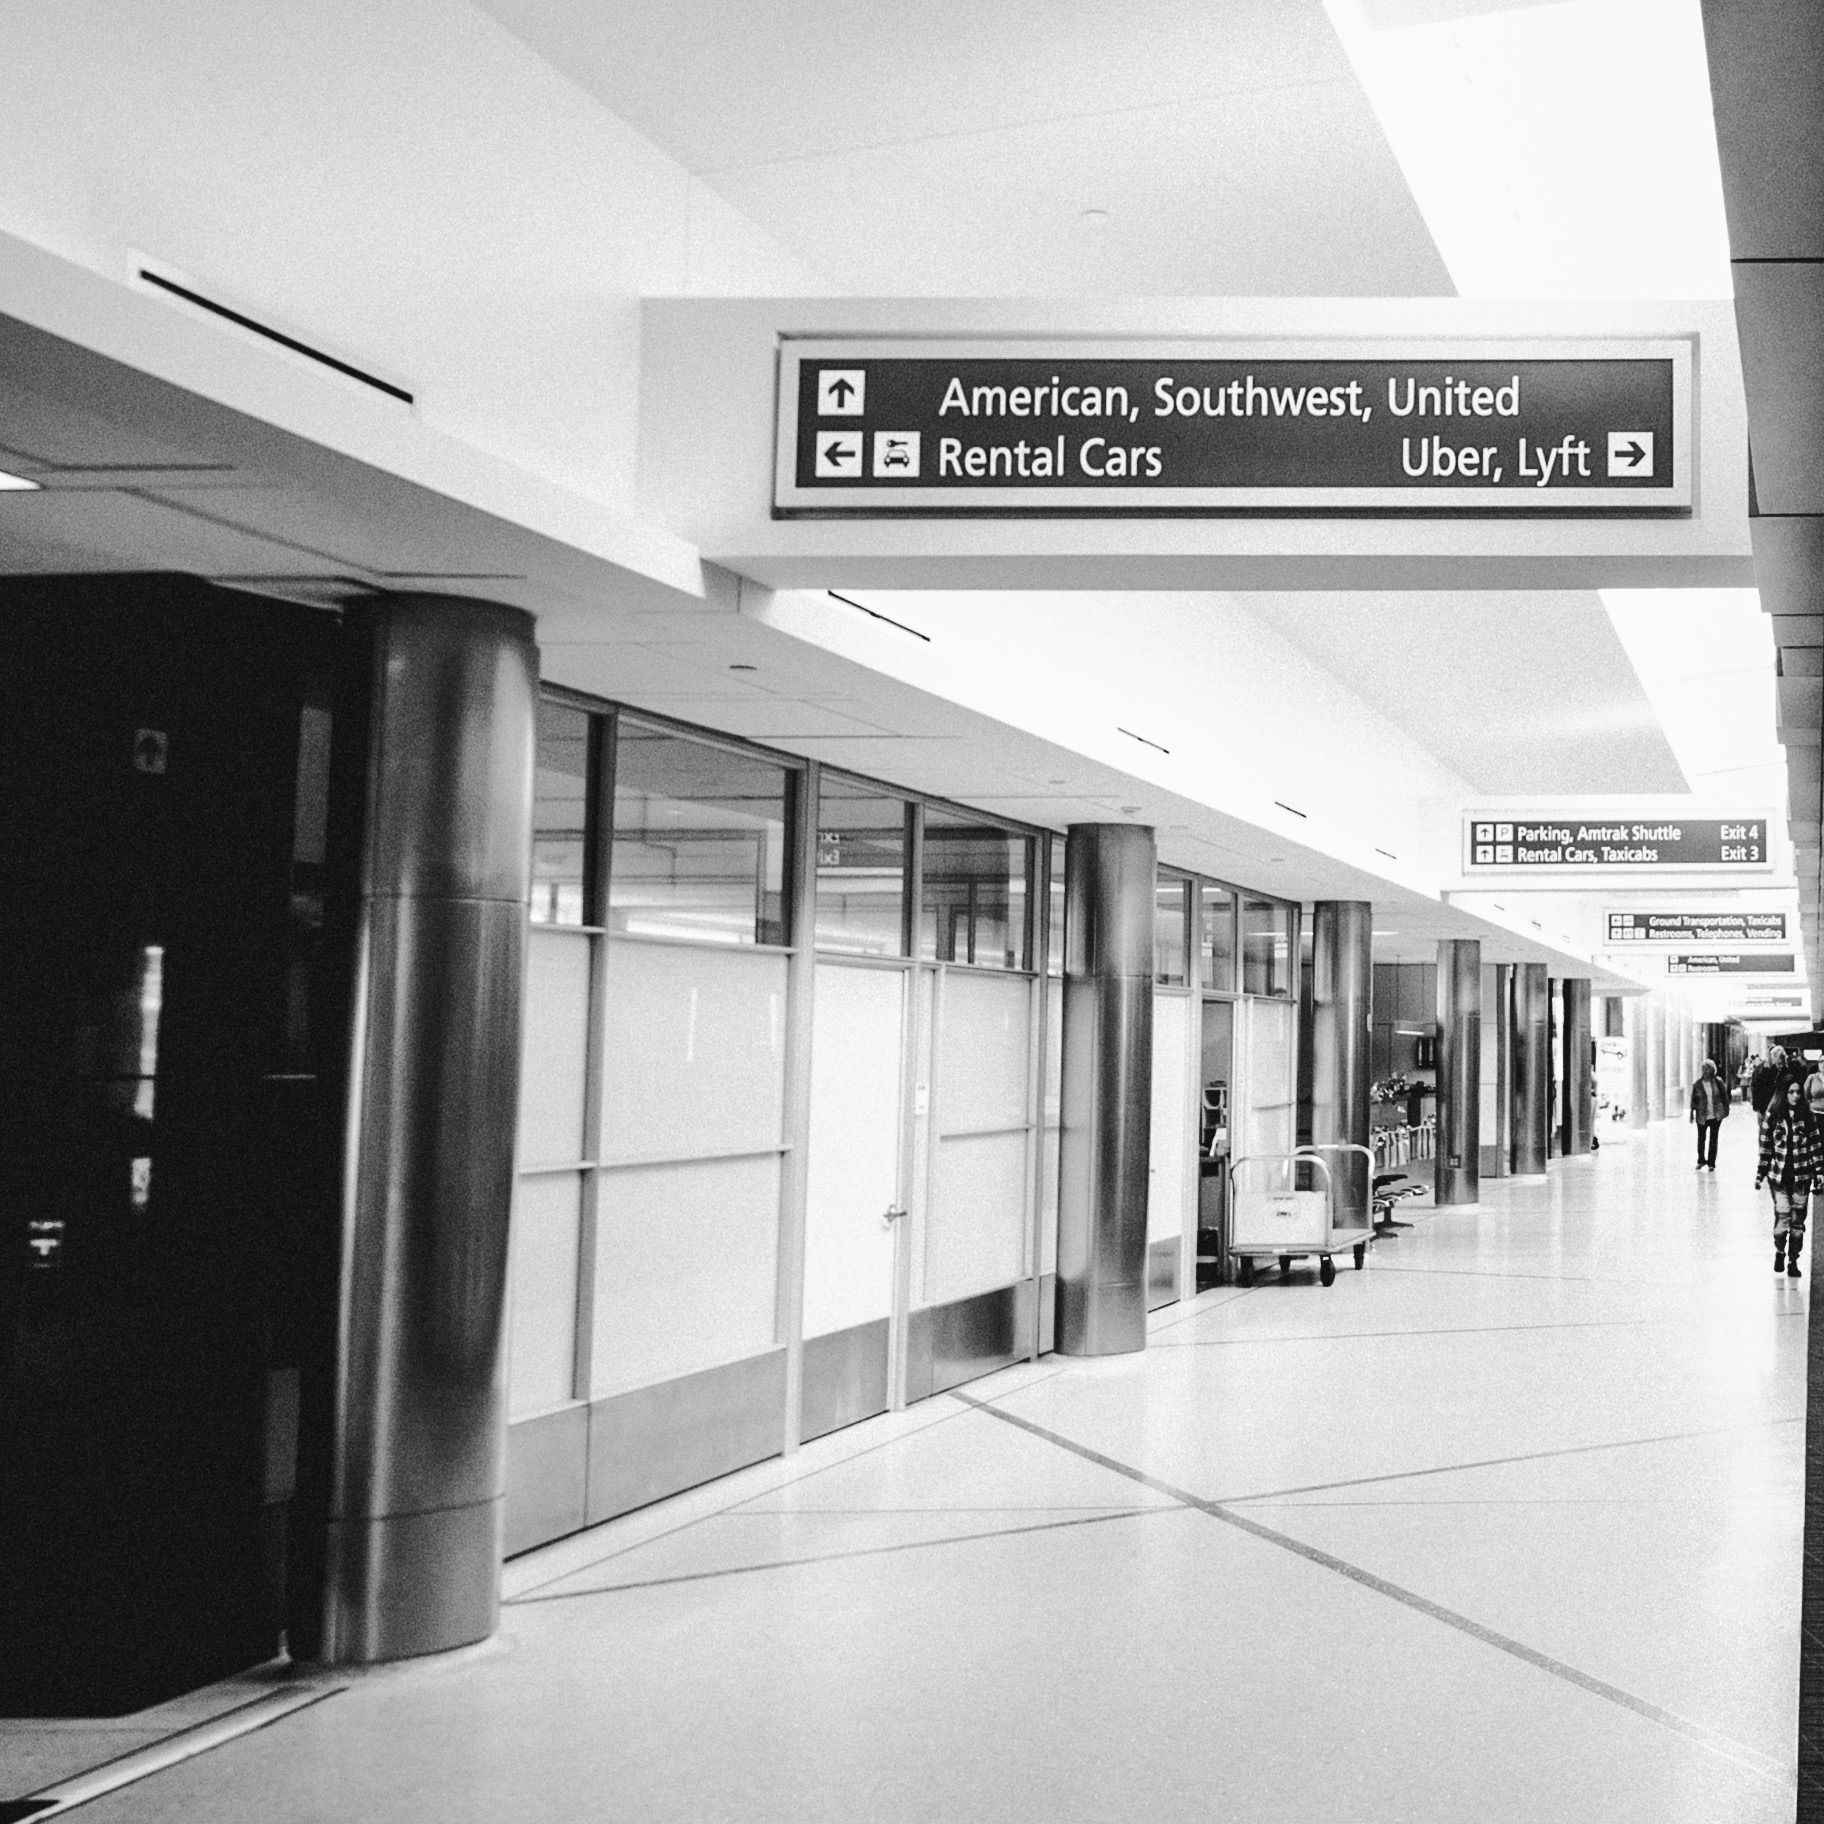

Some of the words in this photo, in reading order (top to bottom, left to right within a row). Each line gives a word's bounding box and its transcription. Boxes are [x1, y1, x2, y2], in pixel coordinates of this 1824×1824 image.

[938, 375, 1140, 421] American,
[1154, 375, 1373, 423] Southwest,
[1388, 374, 1520, 417] United
[939, 434, 1066, 477] Rental
[1079, 436, 1163, 477] Cars
[1402, 434, 1504, 483] Uber,
[1518, 433, 1592, 486] Lyft
[1517, 825, 1574, 844] Parking,
[1577, 825, 1630, 841] Amtrak
[1632, 824, 1682, 841] Shuttle
[1720, 824, 1747, 841] Exit
[1748, 825, 1759, 840] 4
[1517, 845, 1562, 862] Rental
[1564, 846, 1599, 864] Cars,
[1601, 845, 1659, 862] Taxicabs
[1721, 845, 1748, 861] Exit
[1749, 845, 1760, 861] 3
[1649, 916, 1682, 927] Ground
[1682, 915, 1746, 928] Transportation,
[1747, 915, 1782, 926] Taxicabs
[1648, 928, 1695, 939] Restrooms,
[1695, 928, 1746, 939] Telephones,
[1746, 928, 1782, 939] Vending
